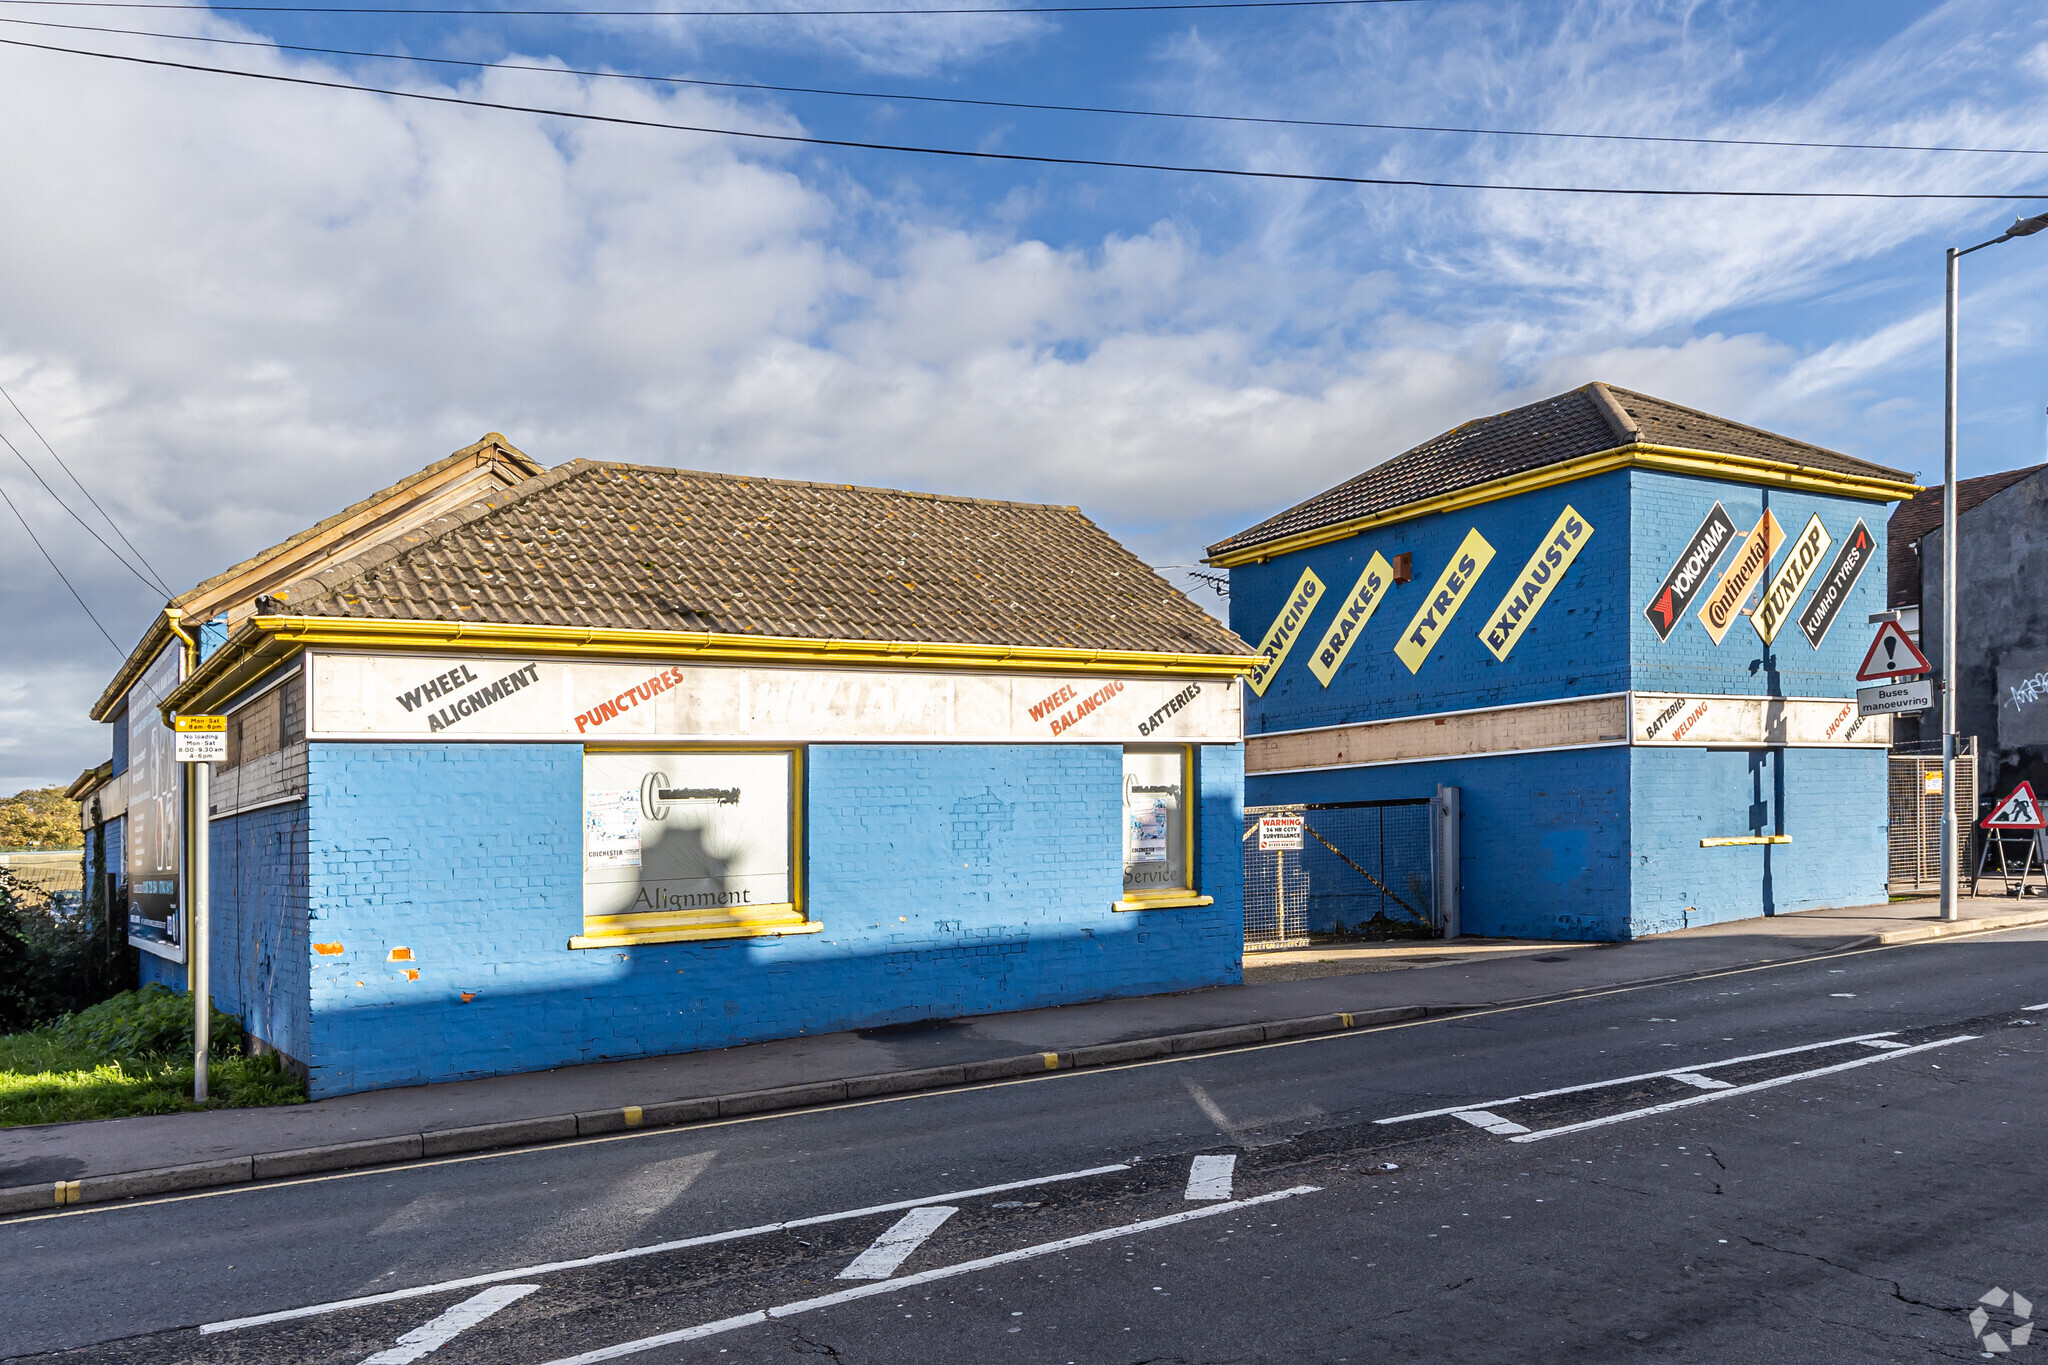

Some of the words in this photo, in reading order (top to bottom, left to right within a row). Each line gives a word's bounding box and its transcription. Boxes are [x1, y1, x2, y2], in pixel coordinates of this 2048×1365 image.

[1487, 516, 1584, 652] EXHAUSTS
[1671, 520, 1728, 600] YOKOHAMA
[1709, 532, 1770, 629] Continental
[1760, 525, 1820, 635] DUNLOP
[1319, 571, 1382, 670] BRAKES
[1410, 553, 1477, 649] TYRES
[1806, 585, 1838, 637] KUMHO
[1833, 547, 1860, 589] TYRES
[1253, 579, 1317, 686] SERVICING
[395, 664, 478, 713] WHEEL
[427, 662, 540, 733] ALIGNMENT
[574, 666, 684, 734] PUNCTURES
[1028, 683, 1078, 722] WHEEL
[1050, 679, 1124, 737] BALANCING
[1138, 681, 1202, 737] BATTERIES
[1862, 697, 1928, 712] manoeuvring
[1878, 688, 1909, 699] Buses
[1645, 698, 1686, 740] BATTERIES
[1672, 701, 1708, 741] WELDING
[1825, 703, 1851, 740] SHOCKS
[1262, 819, 1302, 827] WARNING
[631, 886, 751, 911] Alignment
[1124, 864, 1177, 885] Service
